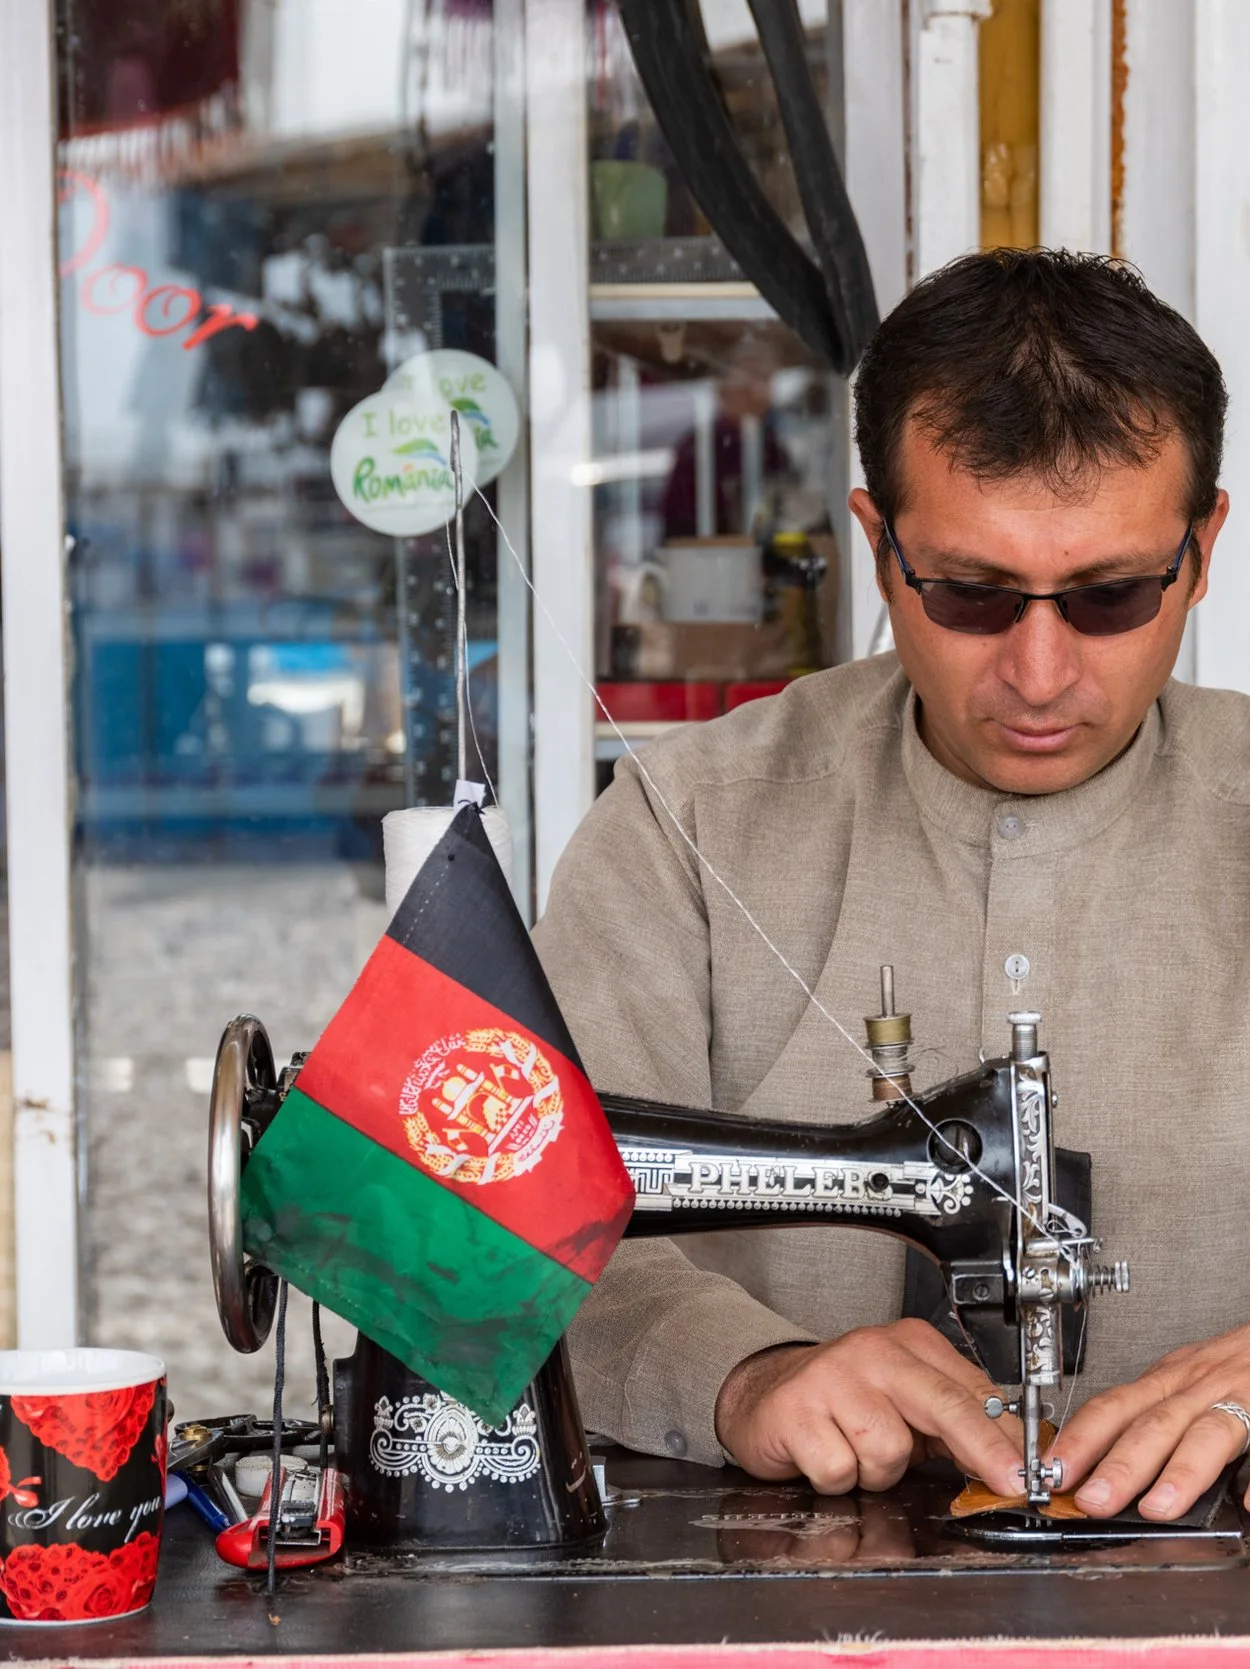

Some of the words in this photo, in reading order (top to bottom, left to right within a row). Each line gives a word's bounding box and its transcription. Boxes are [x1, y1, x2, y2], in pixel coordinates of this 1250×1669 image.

[361, 411, 378, 438] I
[388, 408, 447, 437] love
[8, 1496, 76, 1530] I
[65, 1492, 122, 1530] love
[123, 1496, 161, 1544] you
